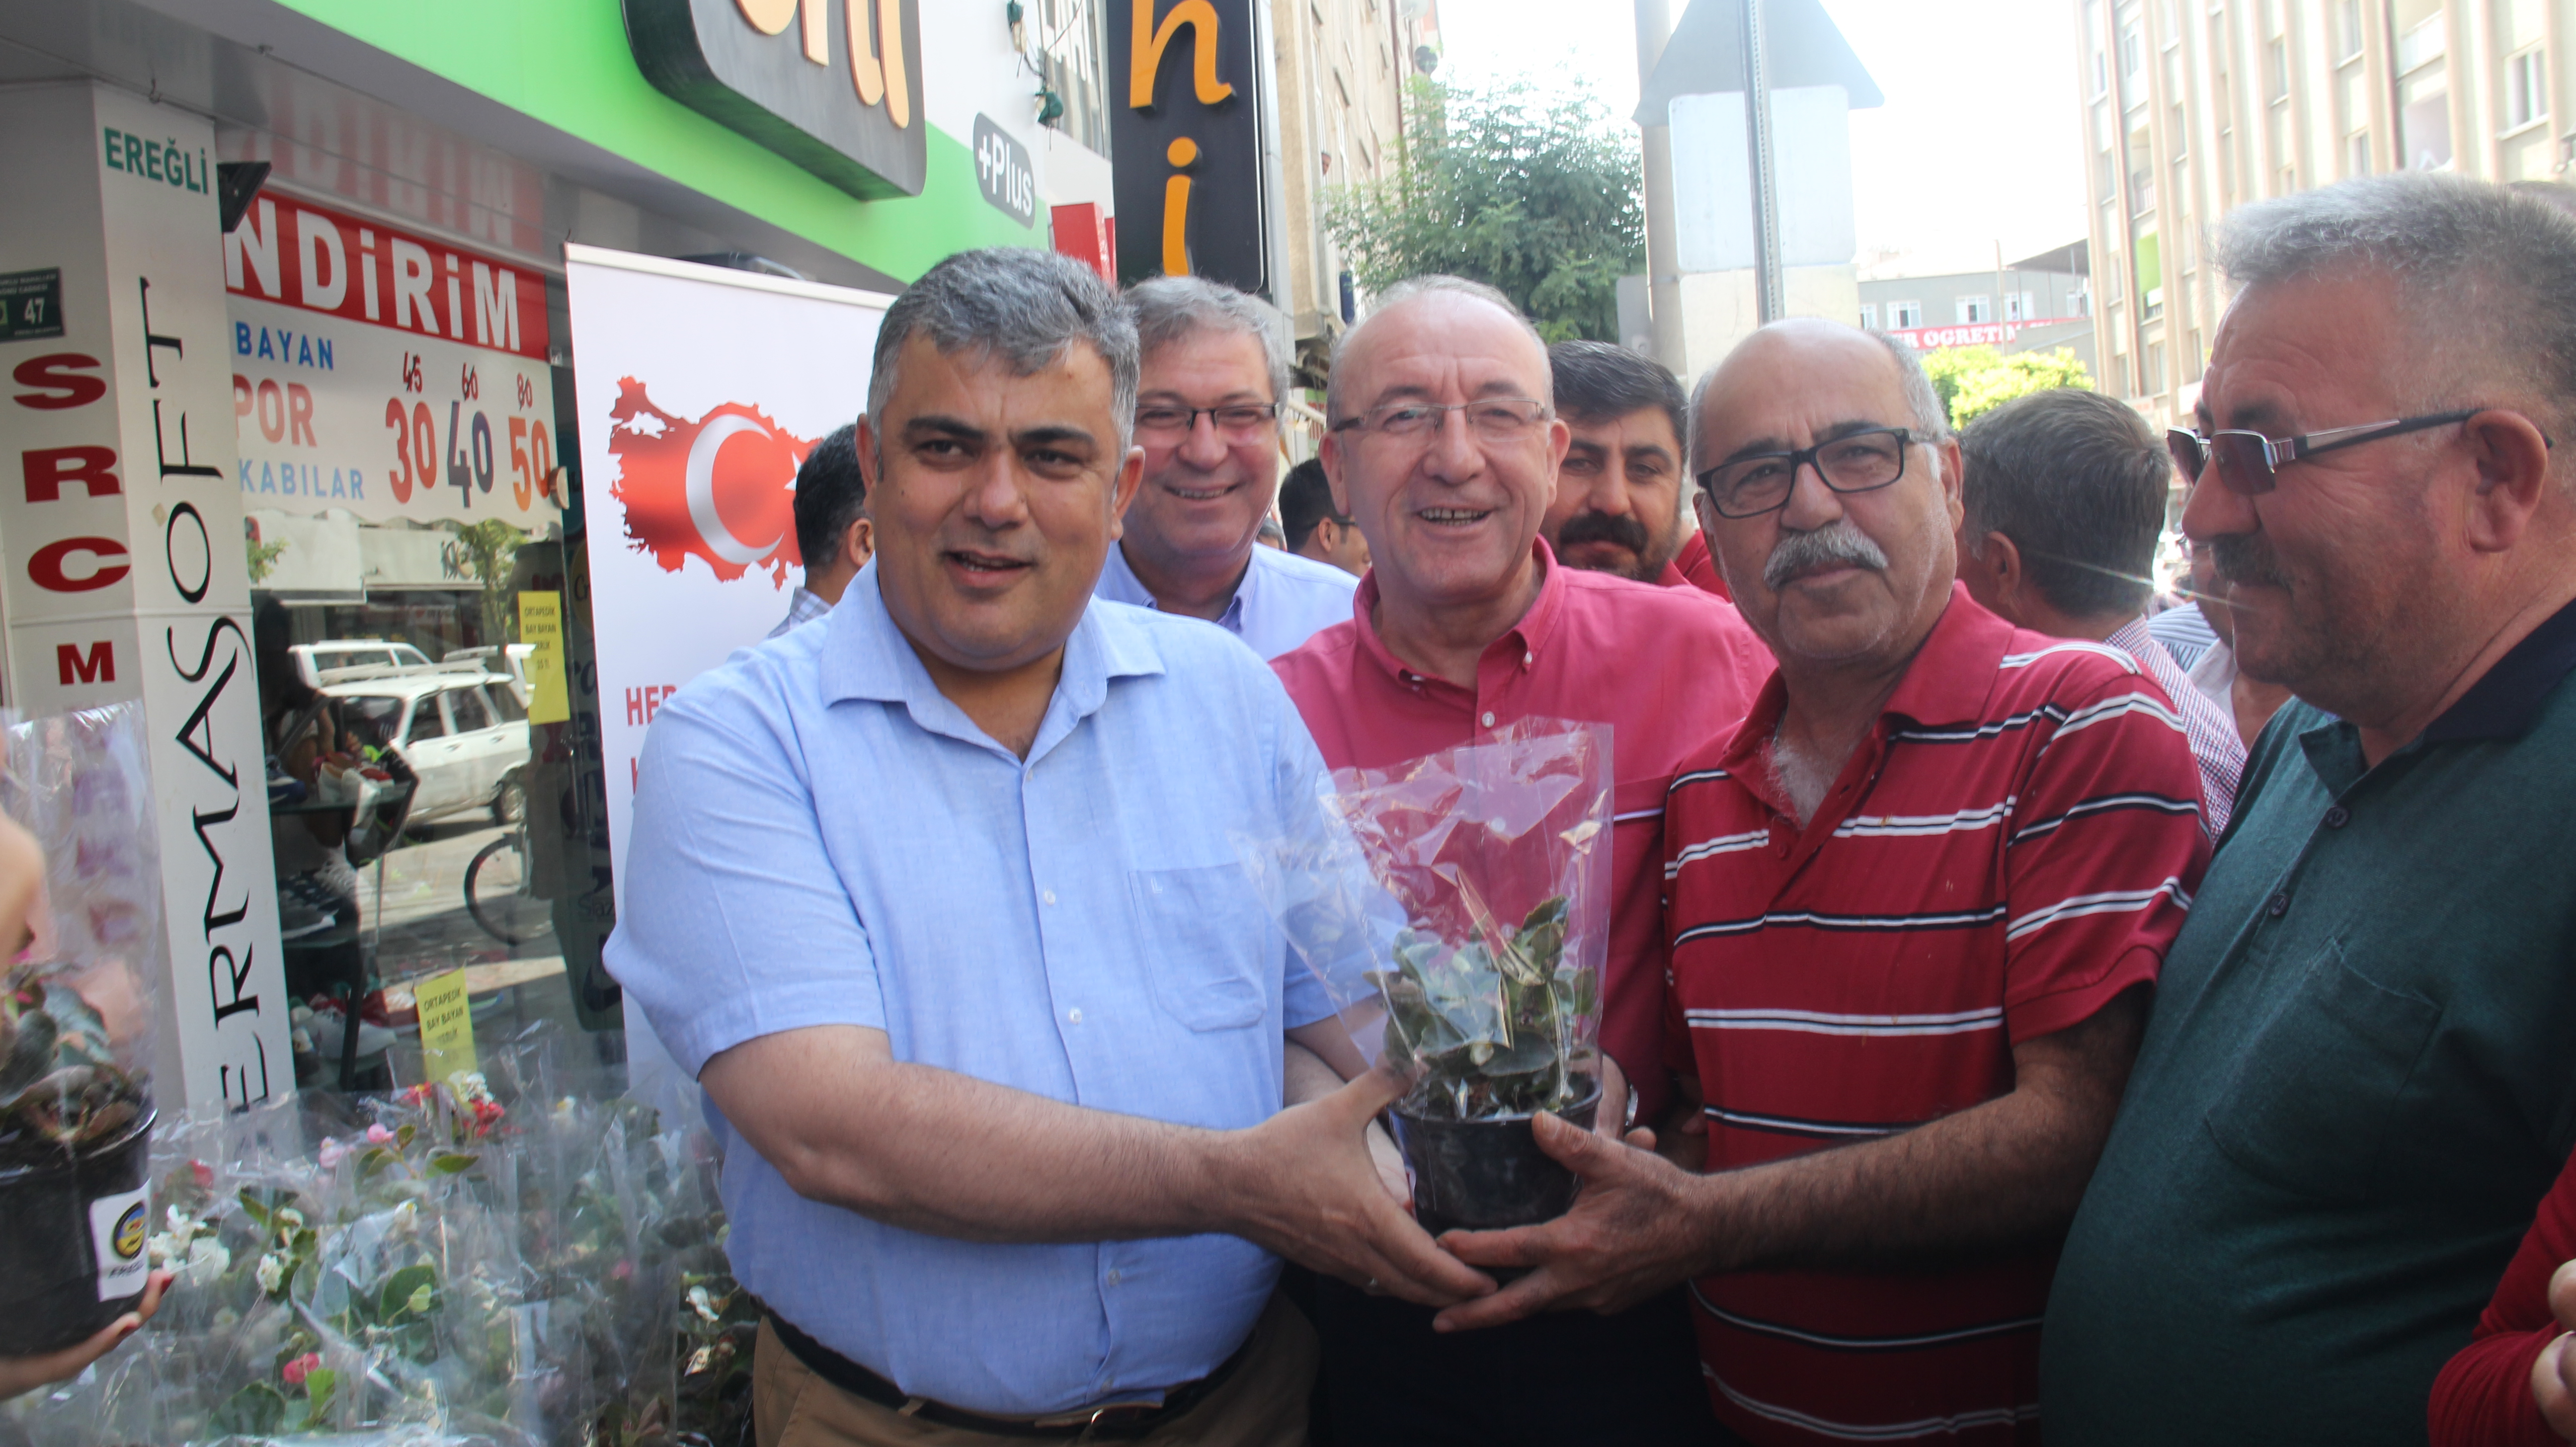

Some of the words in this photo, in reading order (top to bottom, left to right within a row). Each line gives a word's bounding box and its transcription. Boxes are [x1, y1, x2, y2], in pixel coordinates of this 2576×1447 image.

[104, 126, 209, 196] EREĞLİ
[978, 131, 1033, 218] +Plus
[24, 297, 45, 324] 47
[235, 321, 334, 371] BAYAN
[233, 373, 318, 448] POR
[238, 458, 365, 500] KABILAR
[386, 396, 437, 504] 30
[447, 400, 494, 509] 40
[509, 415, 551, 512] 50
